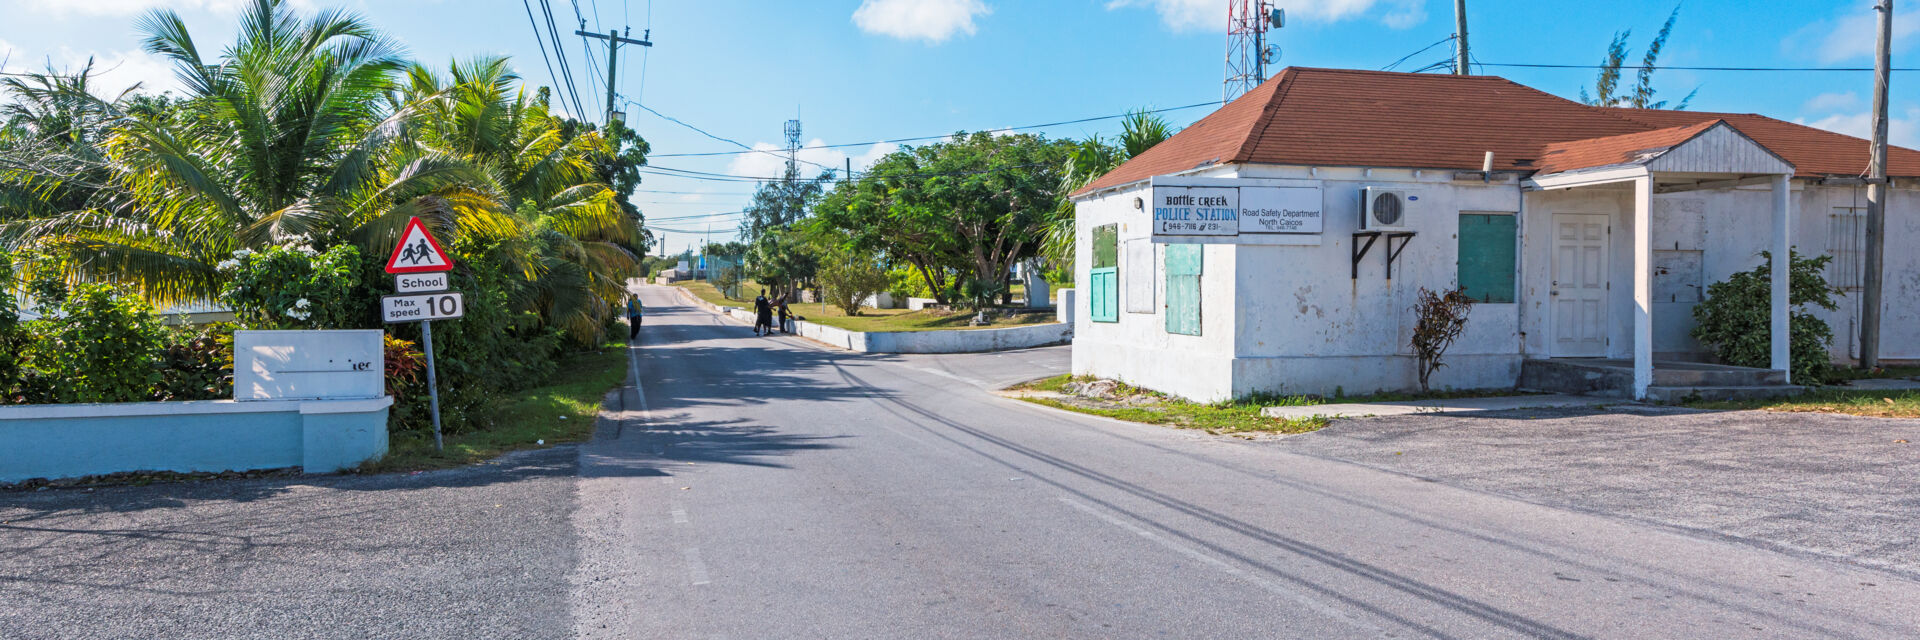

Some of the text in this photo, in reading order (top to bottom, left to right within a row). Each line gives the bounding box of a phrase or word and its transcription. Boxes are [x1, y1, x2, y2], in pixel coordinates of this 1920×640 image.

[1155, 207, 1237, 221] POLICE STATION
[1242, 208, 1320, 218] Road Safety Department
[1258, 218, 1278, 226] North
[402, 277, 444, 288] School
[394, 299, 416, 308] Max
[426, 295, 457, 317] 10
[390, 308, 420, 318] speed
